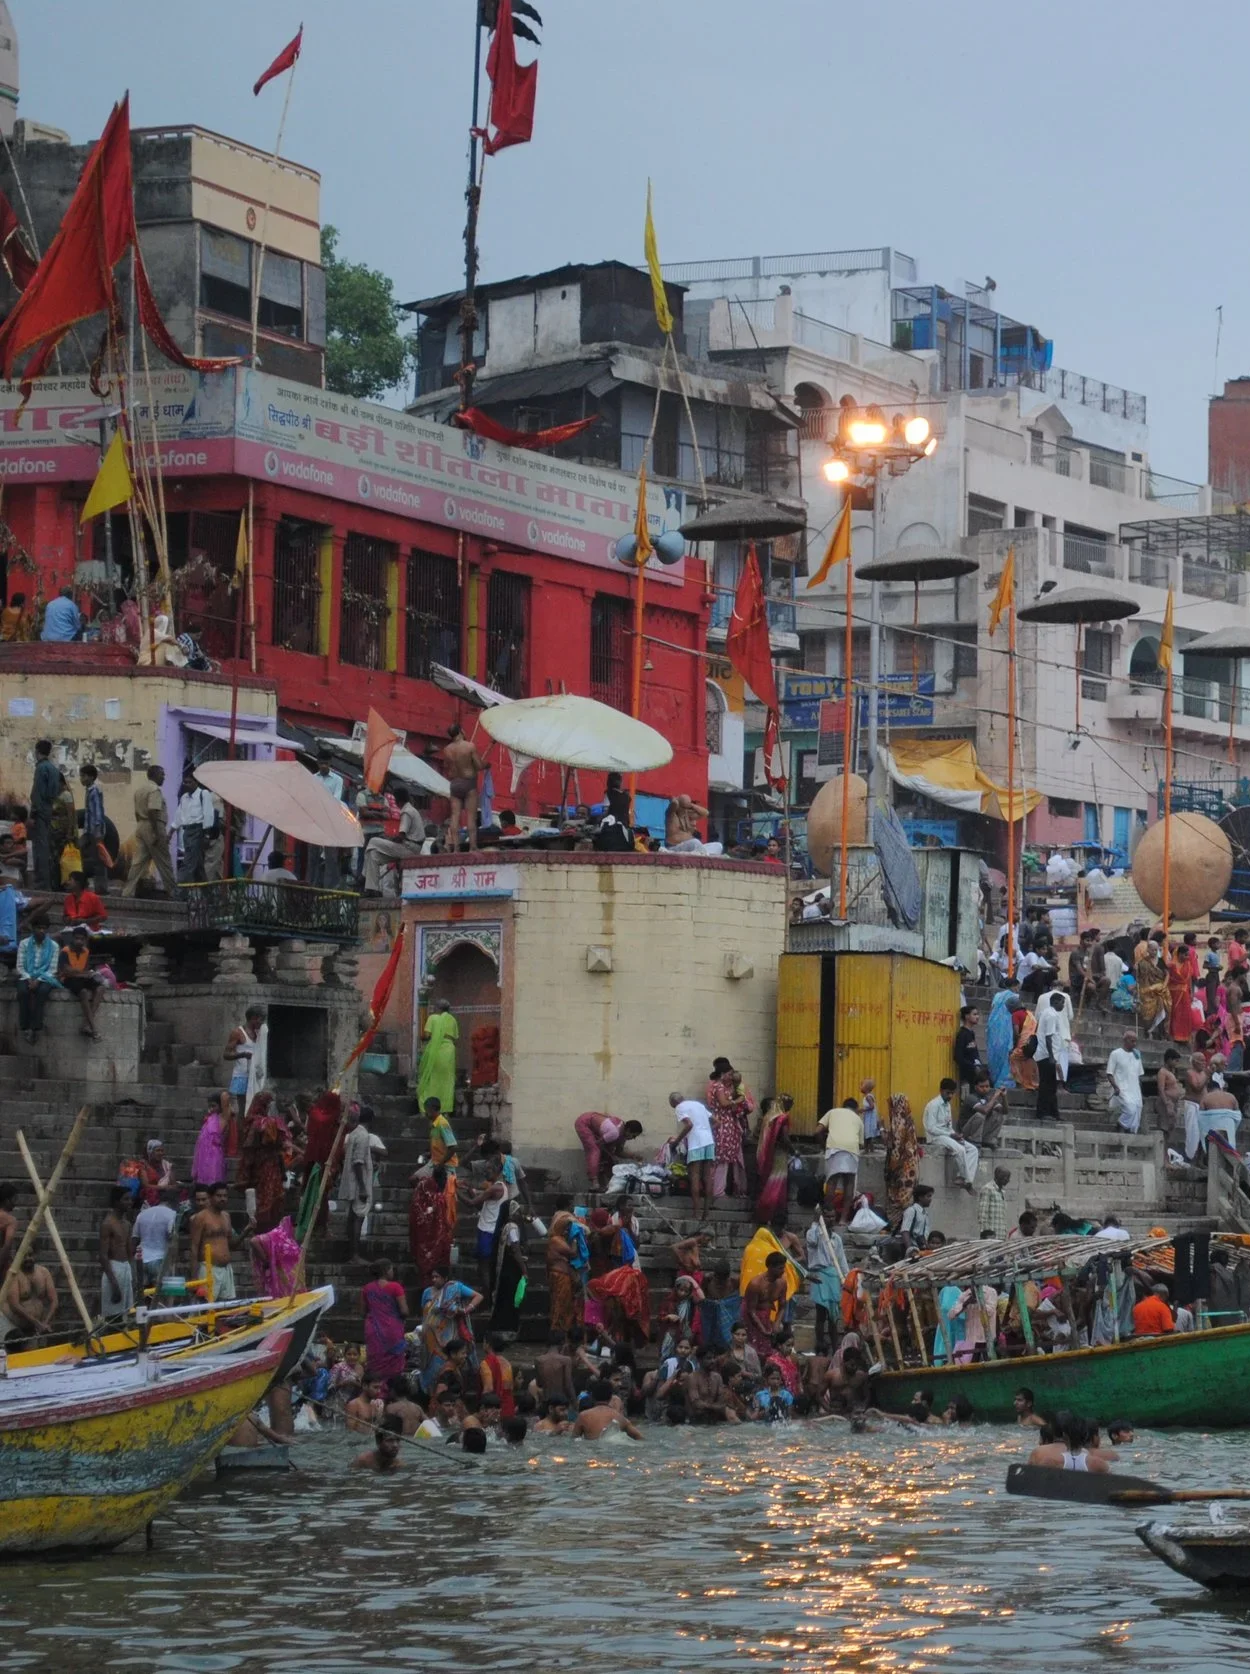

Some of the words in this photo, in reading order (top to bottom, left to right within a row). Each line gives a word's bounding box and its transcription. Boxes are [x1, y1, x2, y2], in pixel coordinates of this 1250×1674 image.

[281, 459, 335, 486] vodafone
[314, 417, 388, 457] बड़ी
[394, 437, 529, 496] शीतला
[535, 480, 630, 523] माता
[372, 483, 421, 509] vodafone
[458, 506, 506, 531] vodafone
[541, 529, 586, 552] vodafone
[414, 874, 440, 890] जय
[451, 866, 467, 888] श्री
[472, 871, 497, 888] राम
